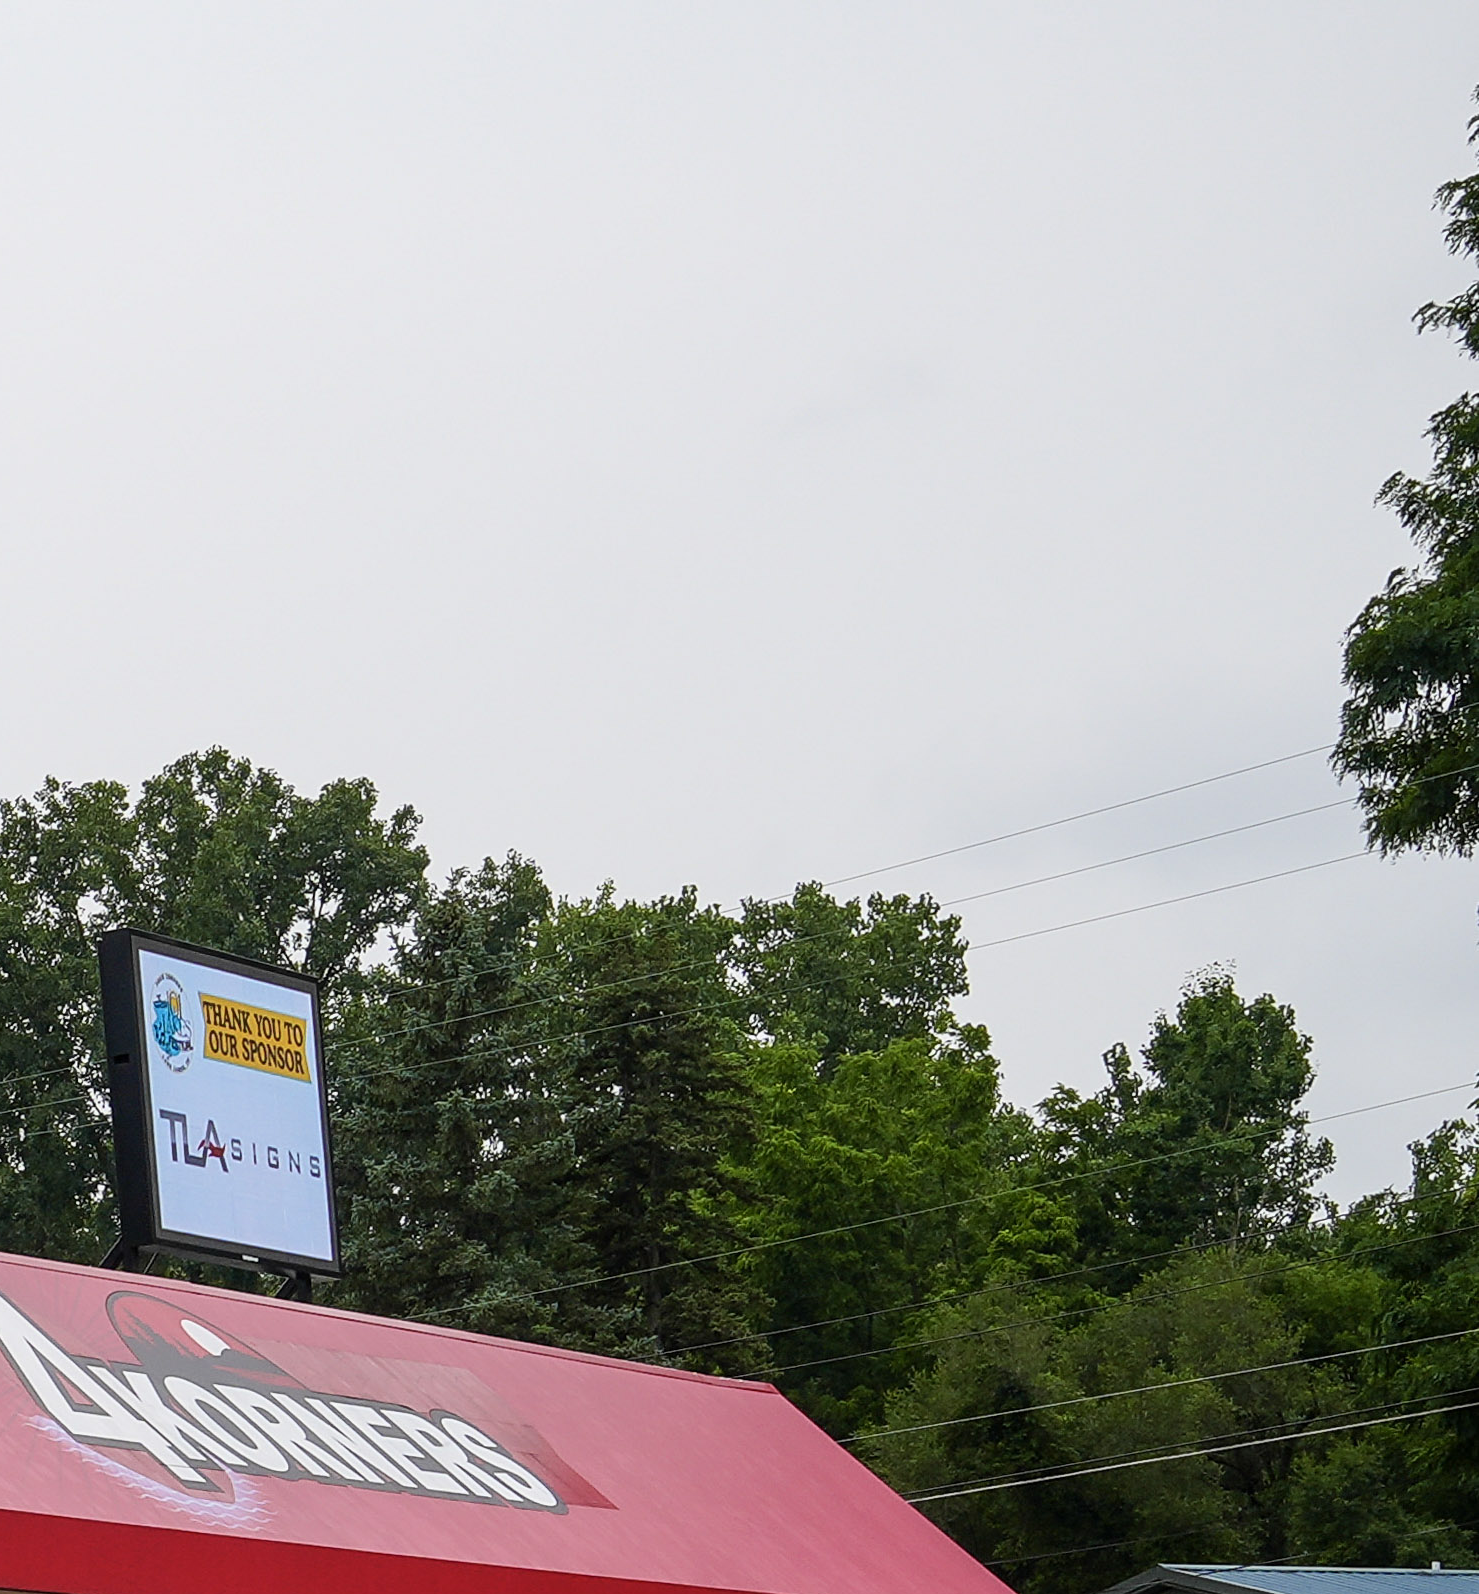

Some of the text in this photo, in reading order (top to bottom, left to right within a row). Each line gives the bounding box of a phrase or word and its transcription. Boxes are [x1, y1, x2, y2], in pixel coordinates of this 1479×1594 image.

[203, 1000, 303, 1047] THANK YOU TO
[209, 1029, 305, 1074] OUR SPONSOR
[160, 1109, 321, 1178] TLA SIGNS
